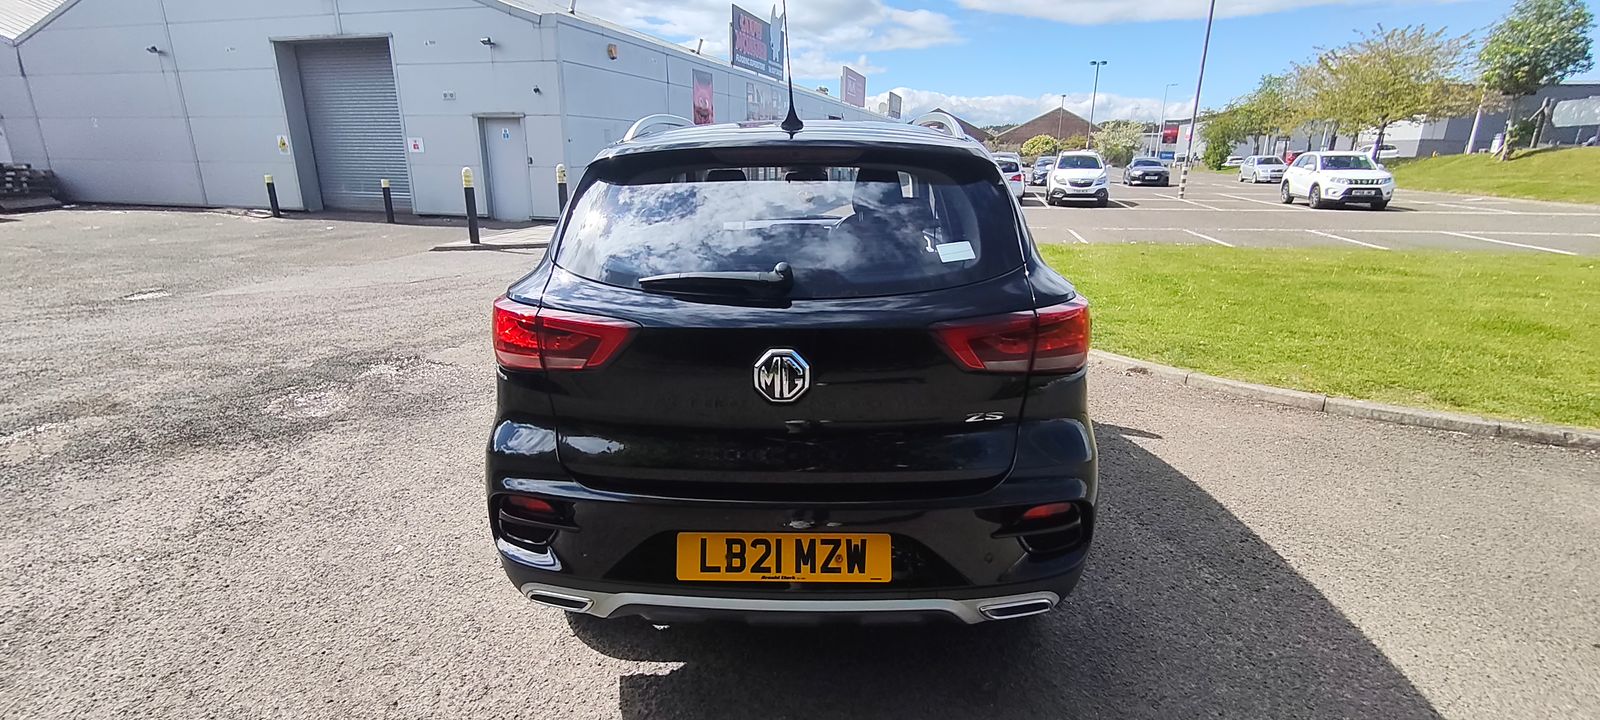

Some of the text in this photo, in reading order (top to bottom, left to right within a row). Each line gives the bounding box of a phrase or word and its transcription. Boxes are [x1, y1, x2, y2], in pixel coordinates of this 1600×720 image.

[759, 356, 803, 398] MG
[964, 411, 1005, 423] ZS
[700, 538, 867, 574] LB21 MZW
